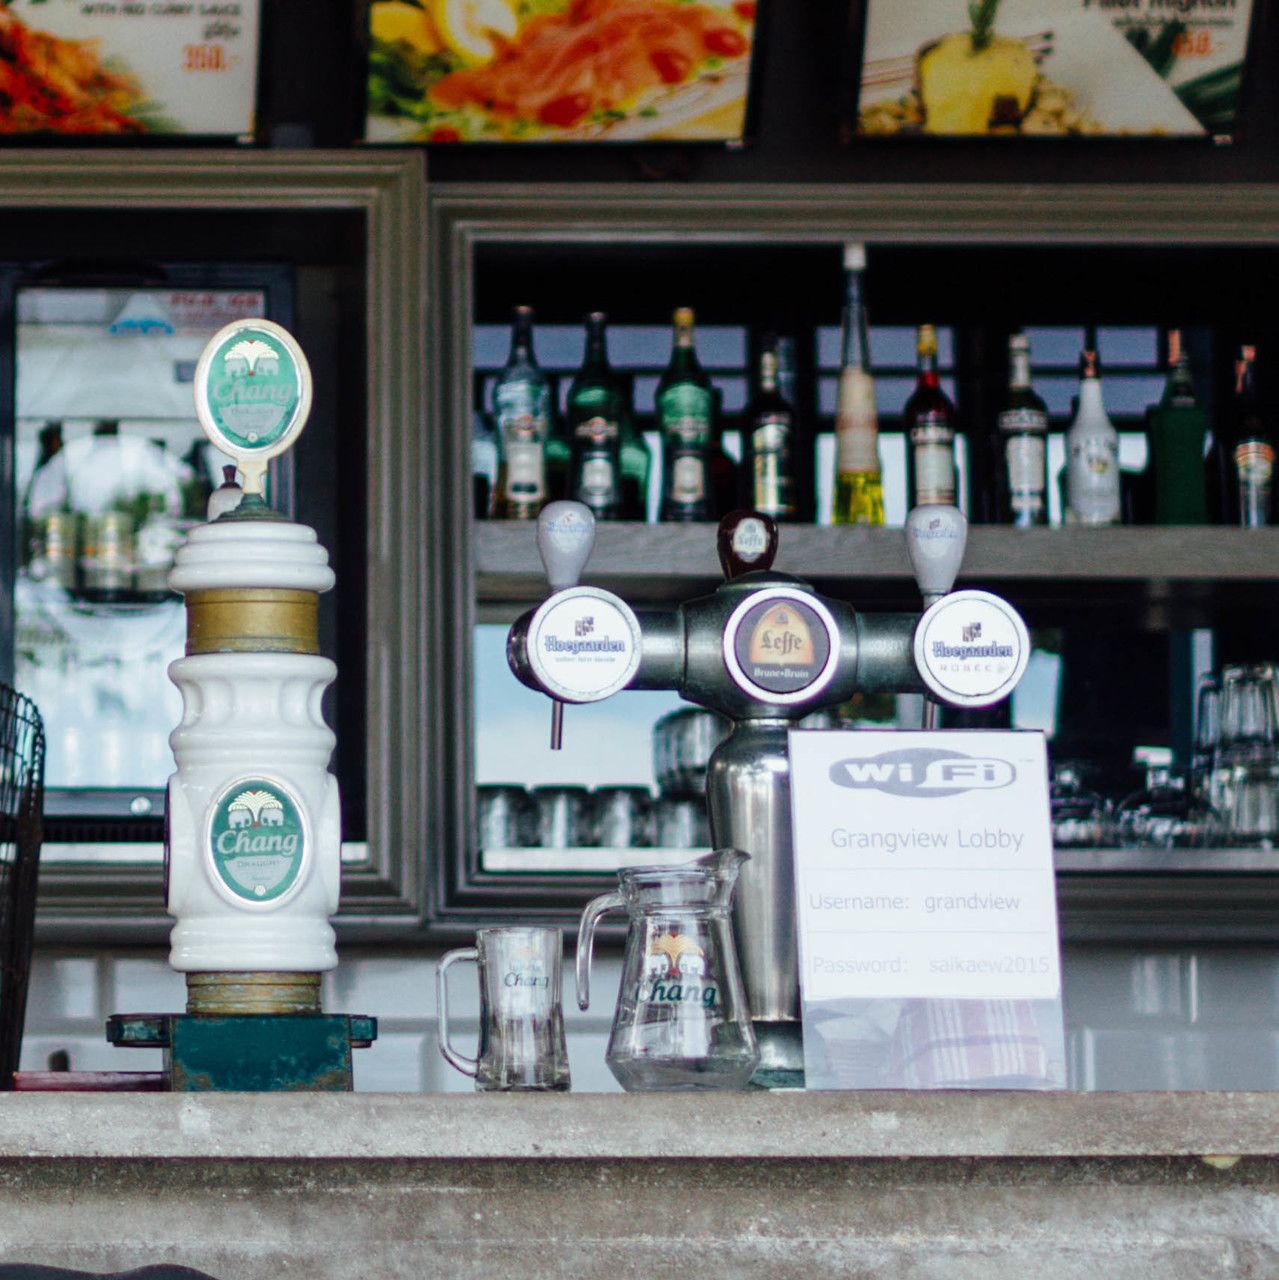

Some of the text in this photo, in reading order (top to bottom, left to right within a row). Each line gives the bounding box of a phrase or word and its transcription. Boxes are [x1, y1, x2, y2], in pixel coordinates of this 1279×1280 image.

[213, 378, 293, 406] Chang
[545, 635, 625, 655] Hoegaarden
[760, 629, 802, 655] Leffe
[933, 641, 1013, 660] Hoegaarden
[217, 829, 298, 859] Chang
[831, 828, 1024, 853] Grangview Lobby
[809, 893, 1020, 913] Username: grandview
[813, 957, 907, 974] Password:
[504, 972, 549, 988] Chang
[635, 979, 717, 1007] Chang
